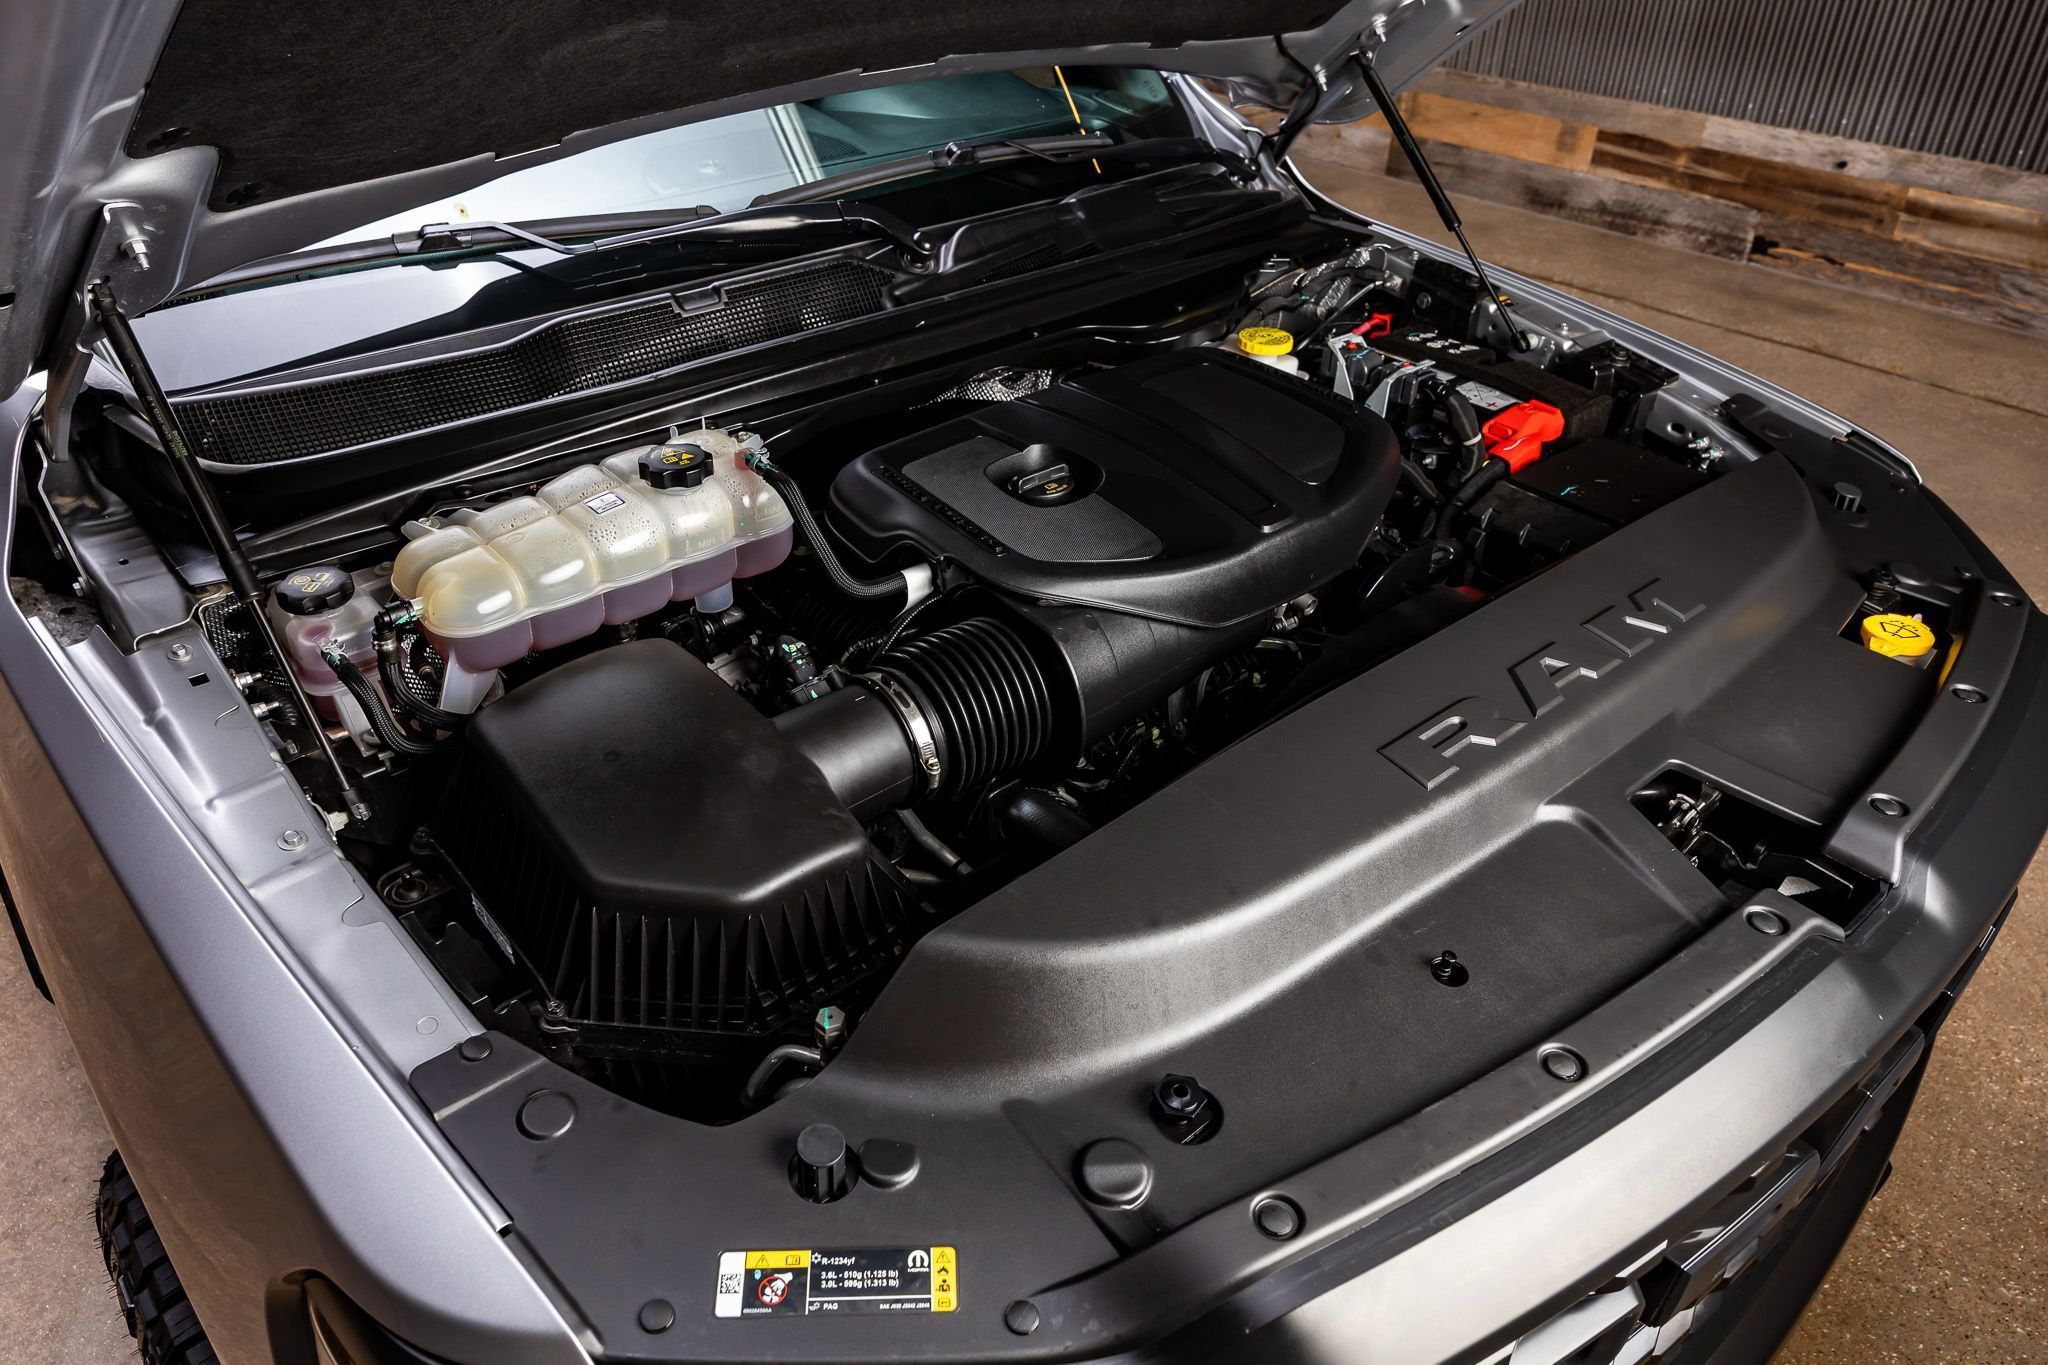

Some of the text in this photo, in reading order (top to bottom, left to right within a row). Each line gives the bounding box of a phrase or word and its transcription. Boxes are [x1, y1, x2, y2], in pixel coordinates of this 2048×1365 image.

[1376, 578, 1706, 791] RAM
[822, 1257, 855, 1266] R-1234yf
[821, 1271, 837, 1279] 3.6L
[888, 1270, 899, 1278] lb)
[821, 1280, 837, 1288] 3.0L
[864, 1279, 887, 1289] (1.313
[888, 1279, 899, 1288] lb)
